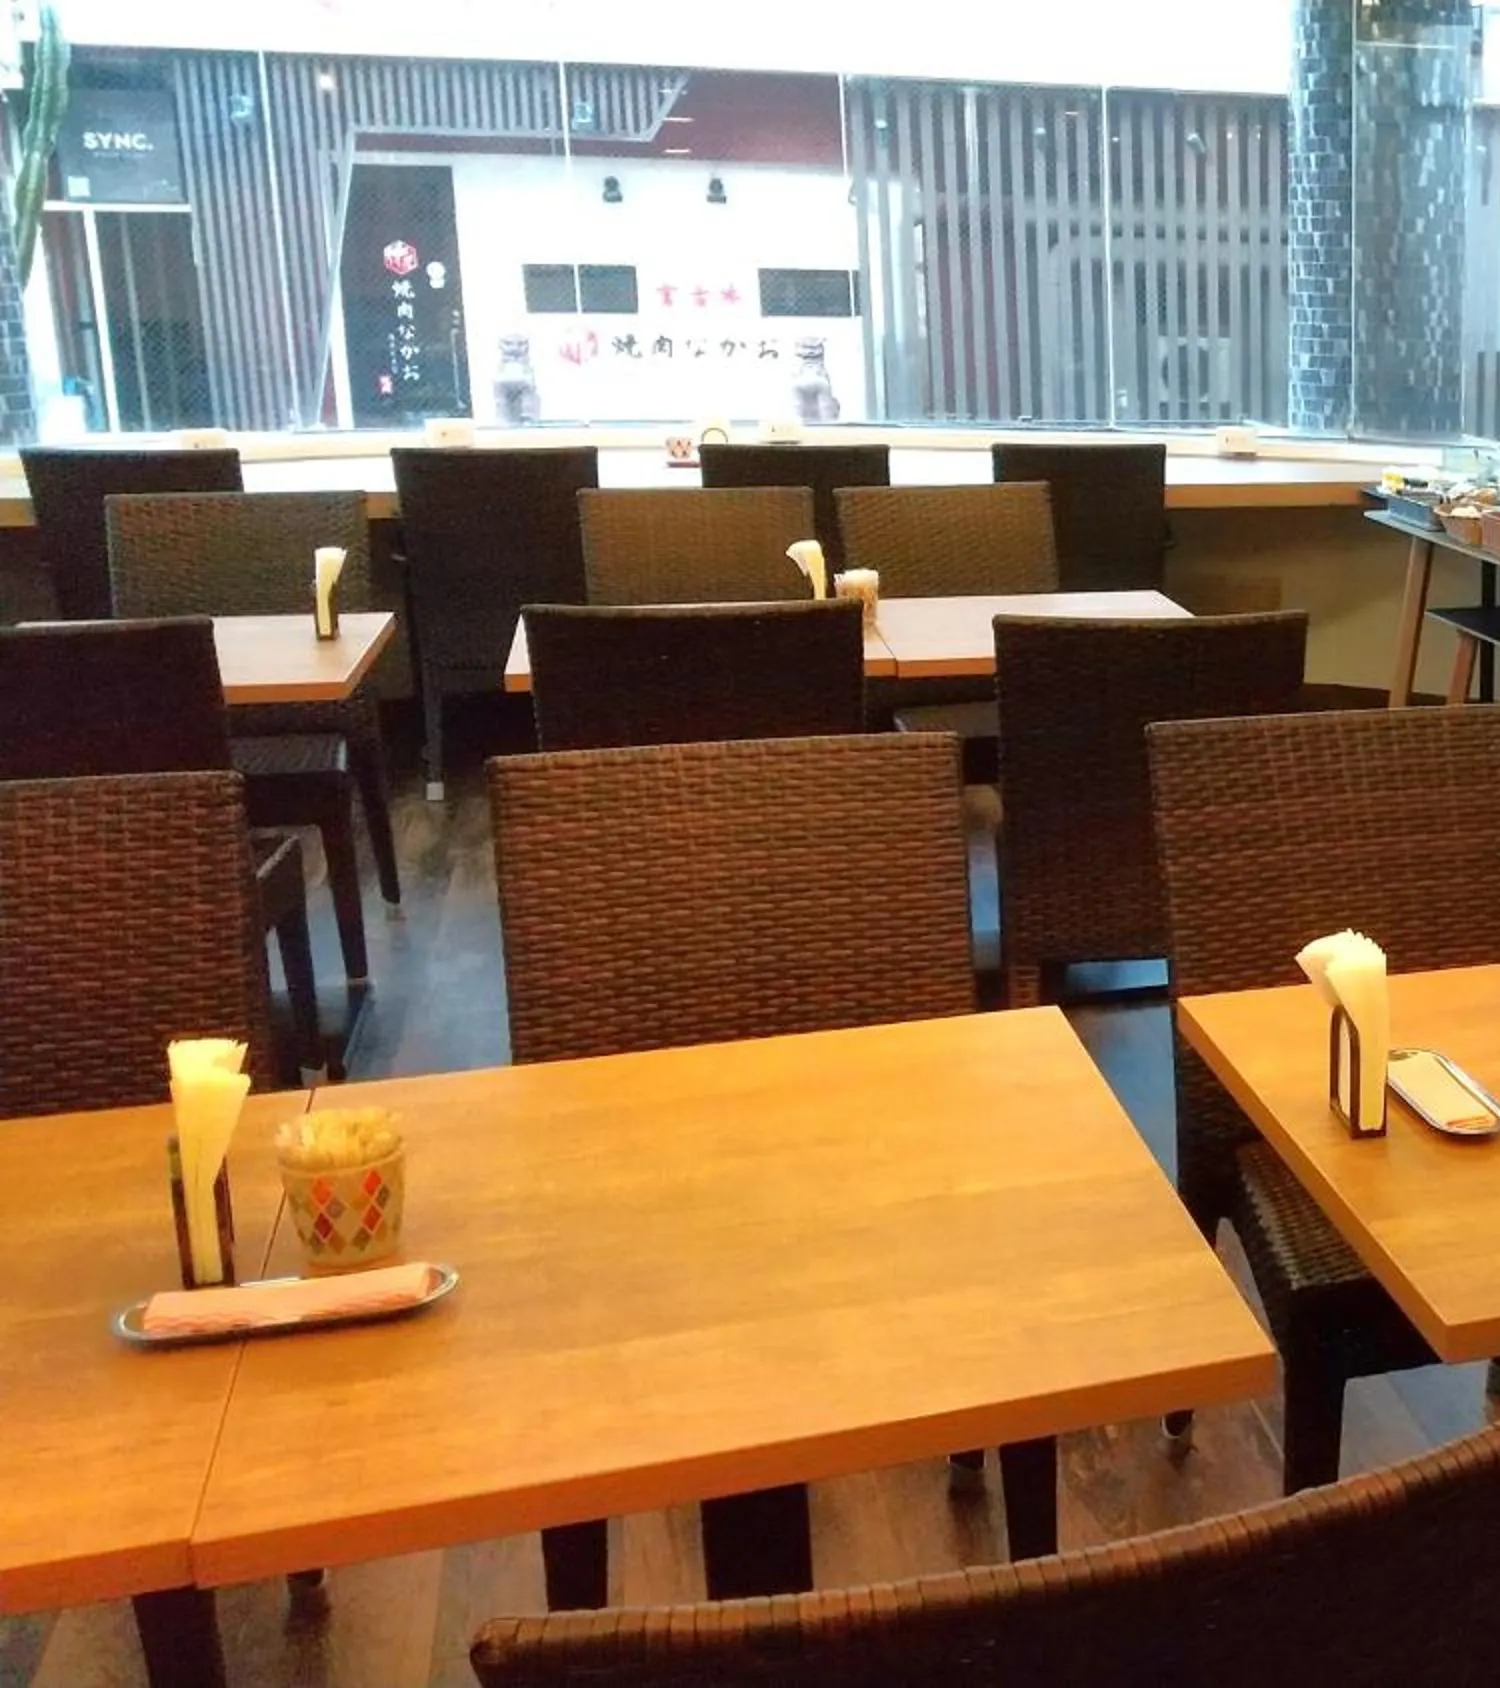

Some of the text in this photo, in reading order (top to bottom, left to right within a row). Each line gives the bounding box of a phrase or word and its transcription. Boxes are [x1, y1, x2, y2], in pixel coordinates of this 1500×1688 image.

[83, 131, 154, 150] SYNC.
[611, 333, 779, 359] 焼肉なかお
